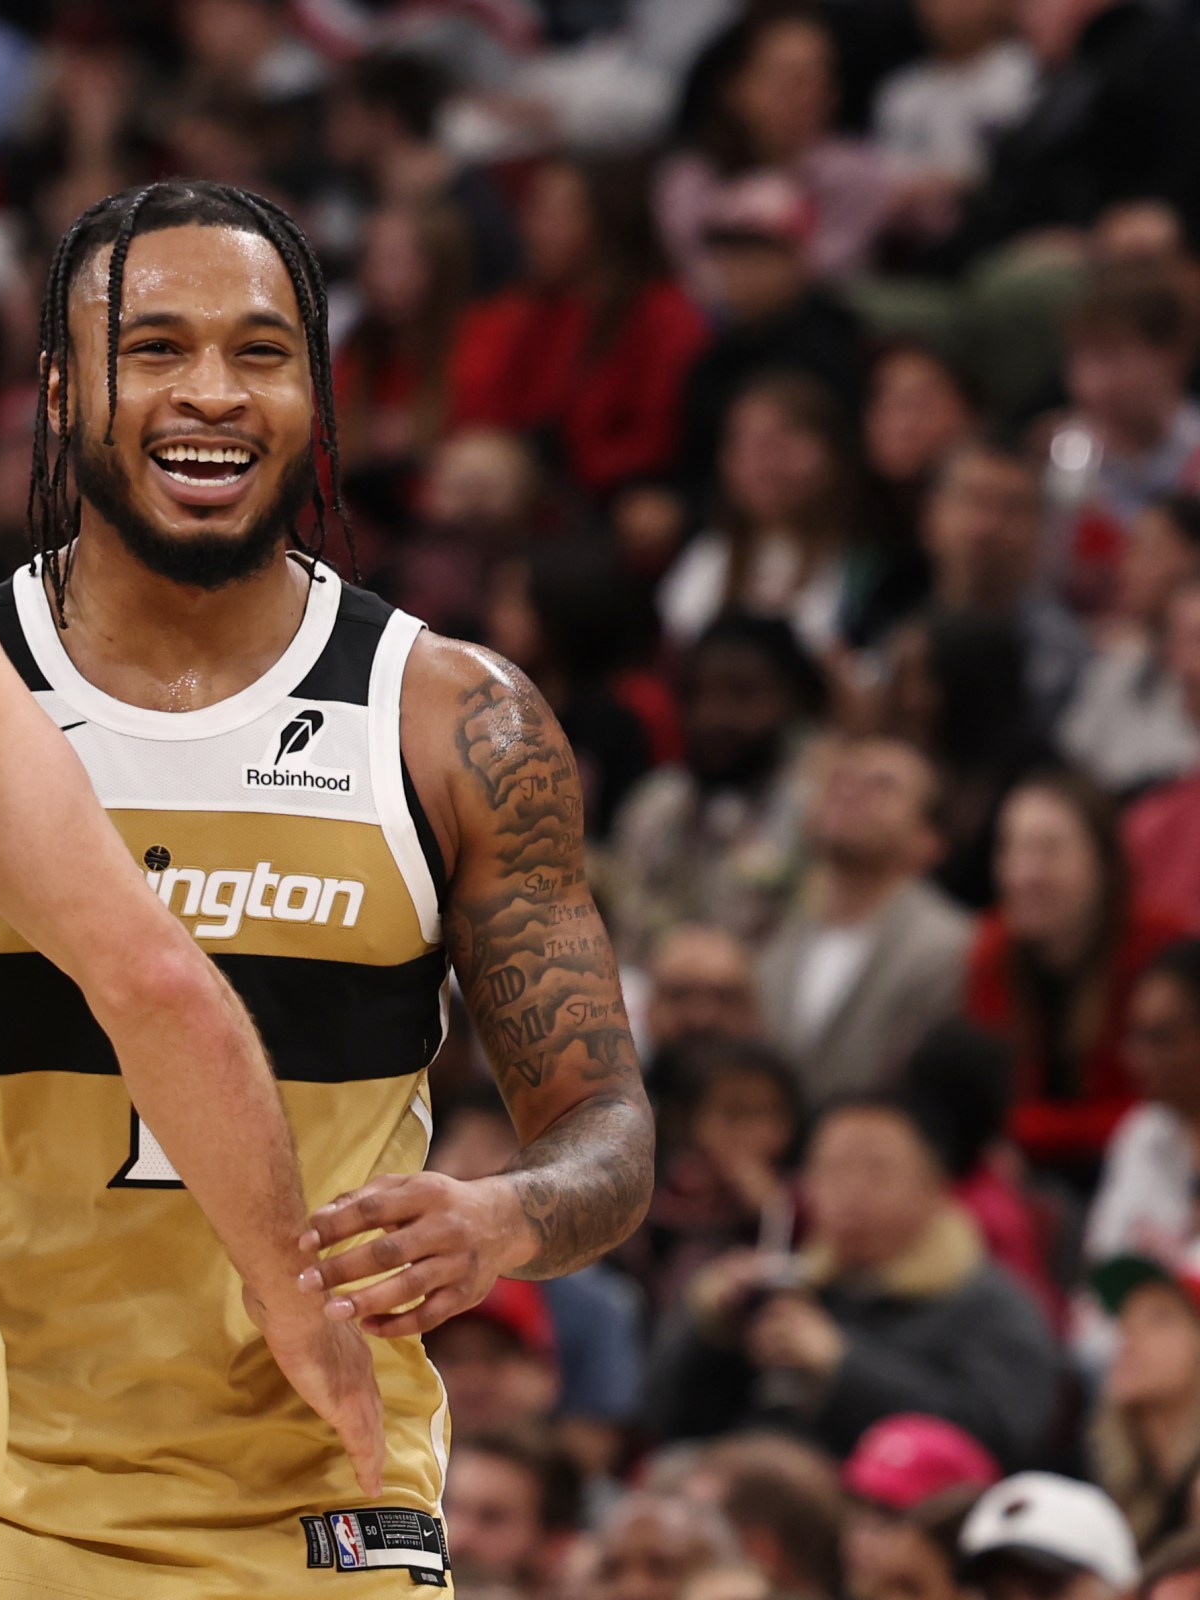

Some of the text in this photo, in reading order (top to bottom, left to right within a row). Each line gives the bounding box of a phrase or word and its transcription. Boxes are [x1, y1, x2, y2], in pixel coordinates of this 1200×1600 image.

[247, 769, 350, 791] Robinhood
[525, 873, 558, 896] Stay
[566, 1001, 609, 1025] They
[365, 1525, 377, 1535] 50
